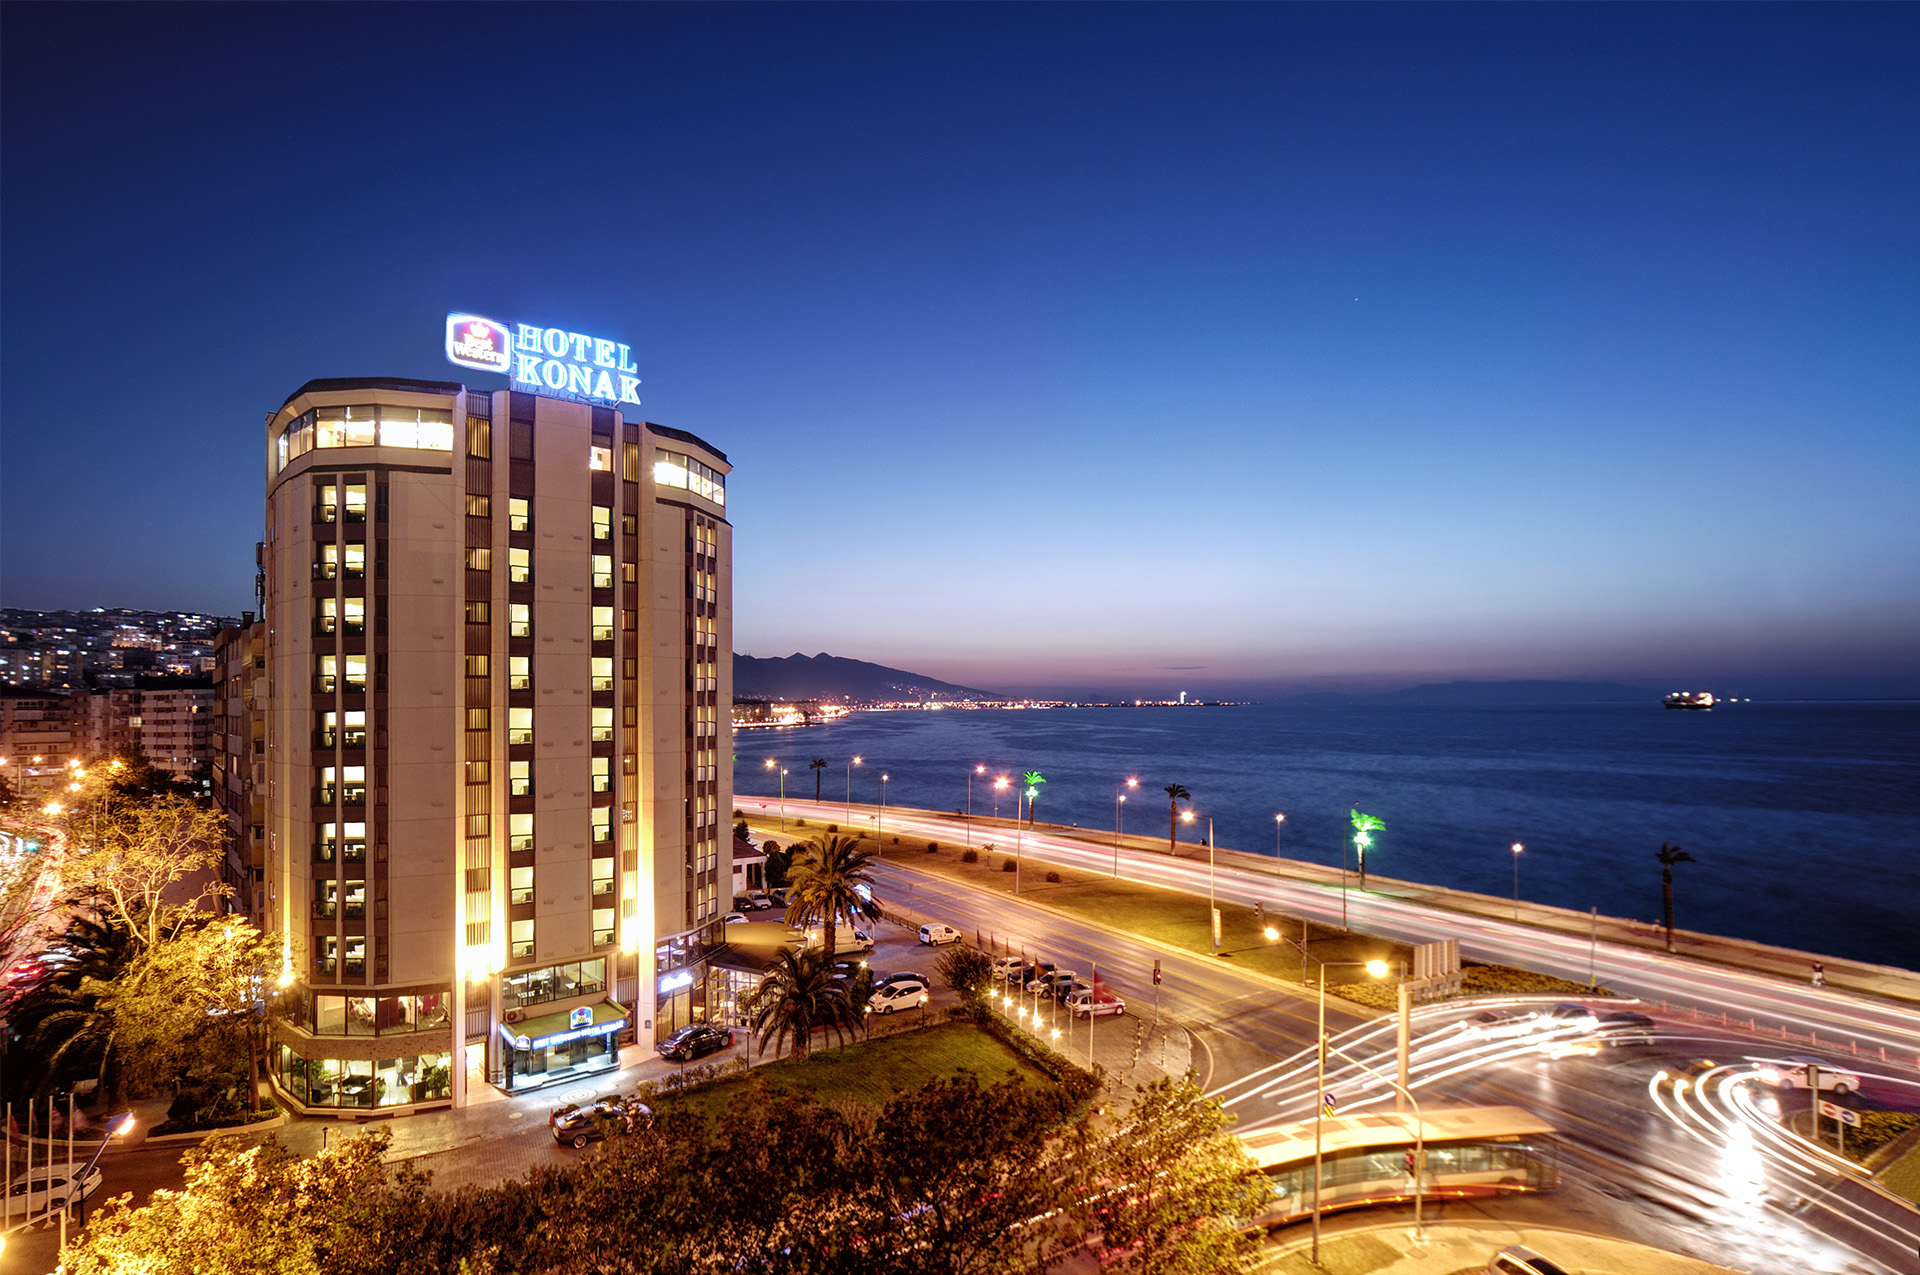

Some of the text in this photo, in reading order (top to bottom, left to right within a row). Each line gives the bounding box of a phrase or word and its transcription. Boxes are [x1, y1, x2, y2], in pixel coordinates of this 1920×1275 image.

[464, 333, 494, 351] Best
[516, 323, 638, 374] HOTEL
[516, 353, 642, 405] KONAK
